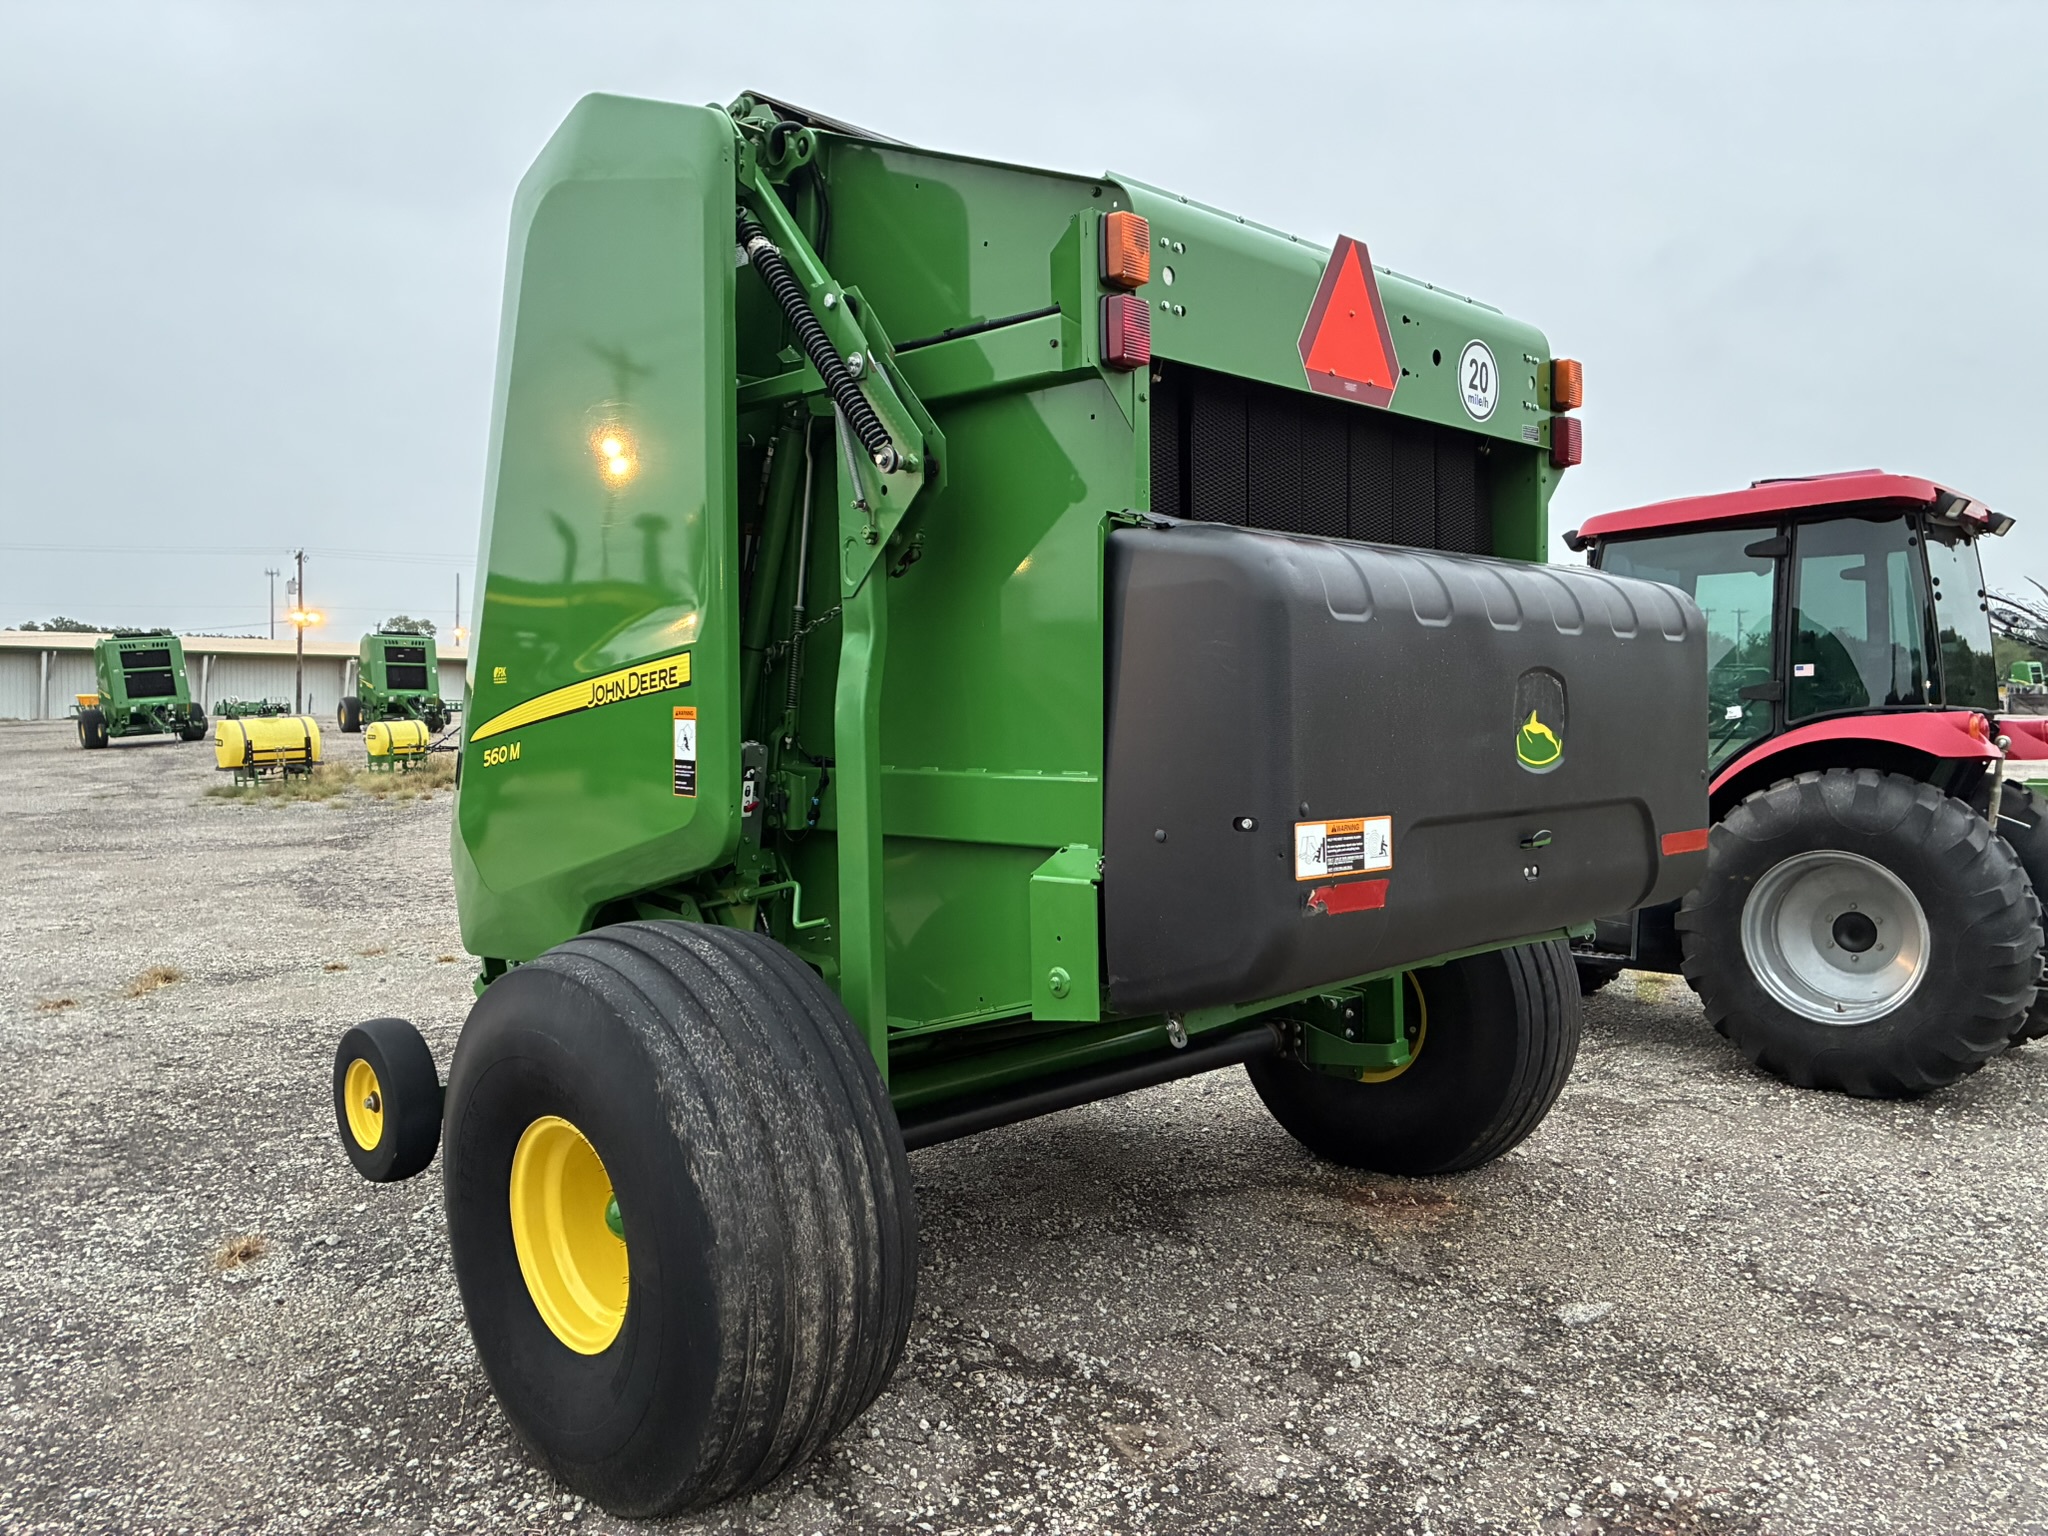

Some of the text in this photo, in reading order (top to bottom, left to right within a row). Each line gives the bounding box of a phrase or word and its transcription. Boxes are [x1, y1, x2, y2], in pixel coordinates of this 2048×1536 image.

[1468, 358, 1489, 394] 20
[1467, 394, 1489, 409] mile/h
[588, 666, 678, 705] JOHN DEERE
[483, 740, 521, 768] 560 M
[1336, 823, 1360, 832] WARNING
